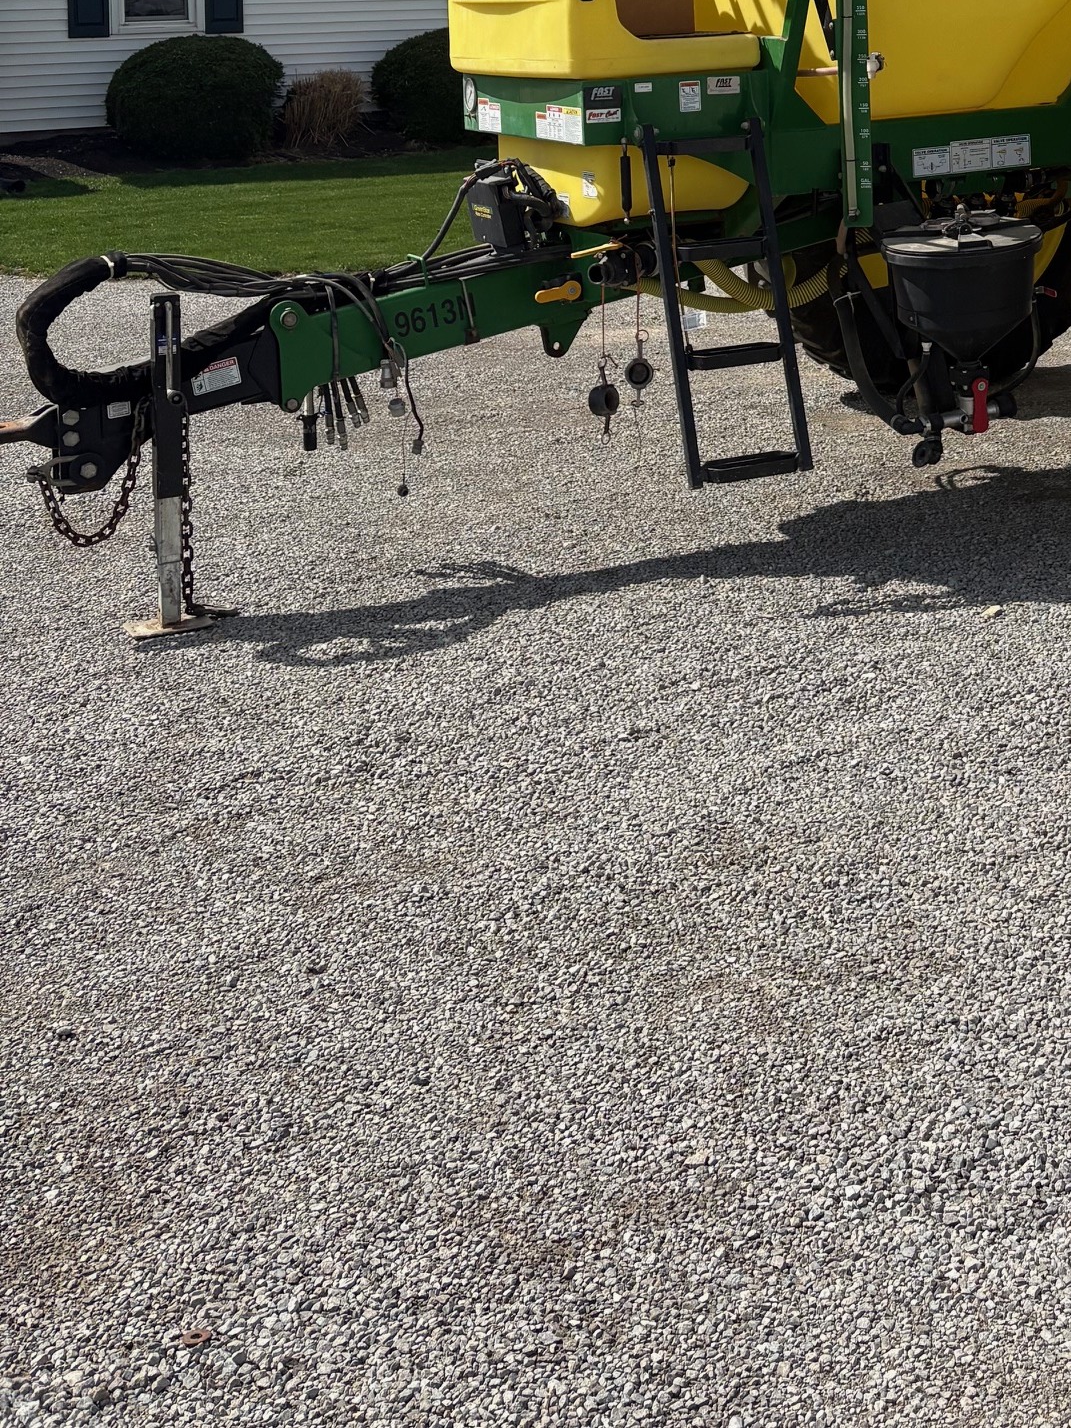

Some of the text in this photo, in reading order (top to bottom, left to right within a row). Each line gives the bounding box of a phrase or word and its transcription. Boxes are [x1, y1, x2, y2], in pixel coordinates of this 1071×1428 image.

[590, 86, 615, 100] FAST
[394, 292, 477, 338] 9613N
[209, 359, 236, 371] DANGER
